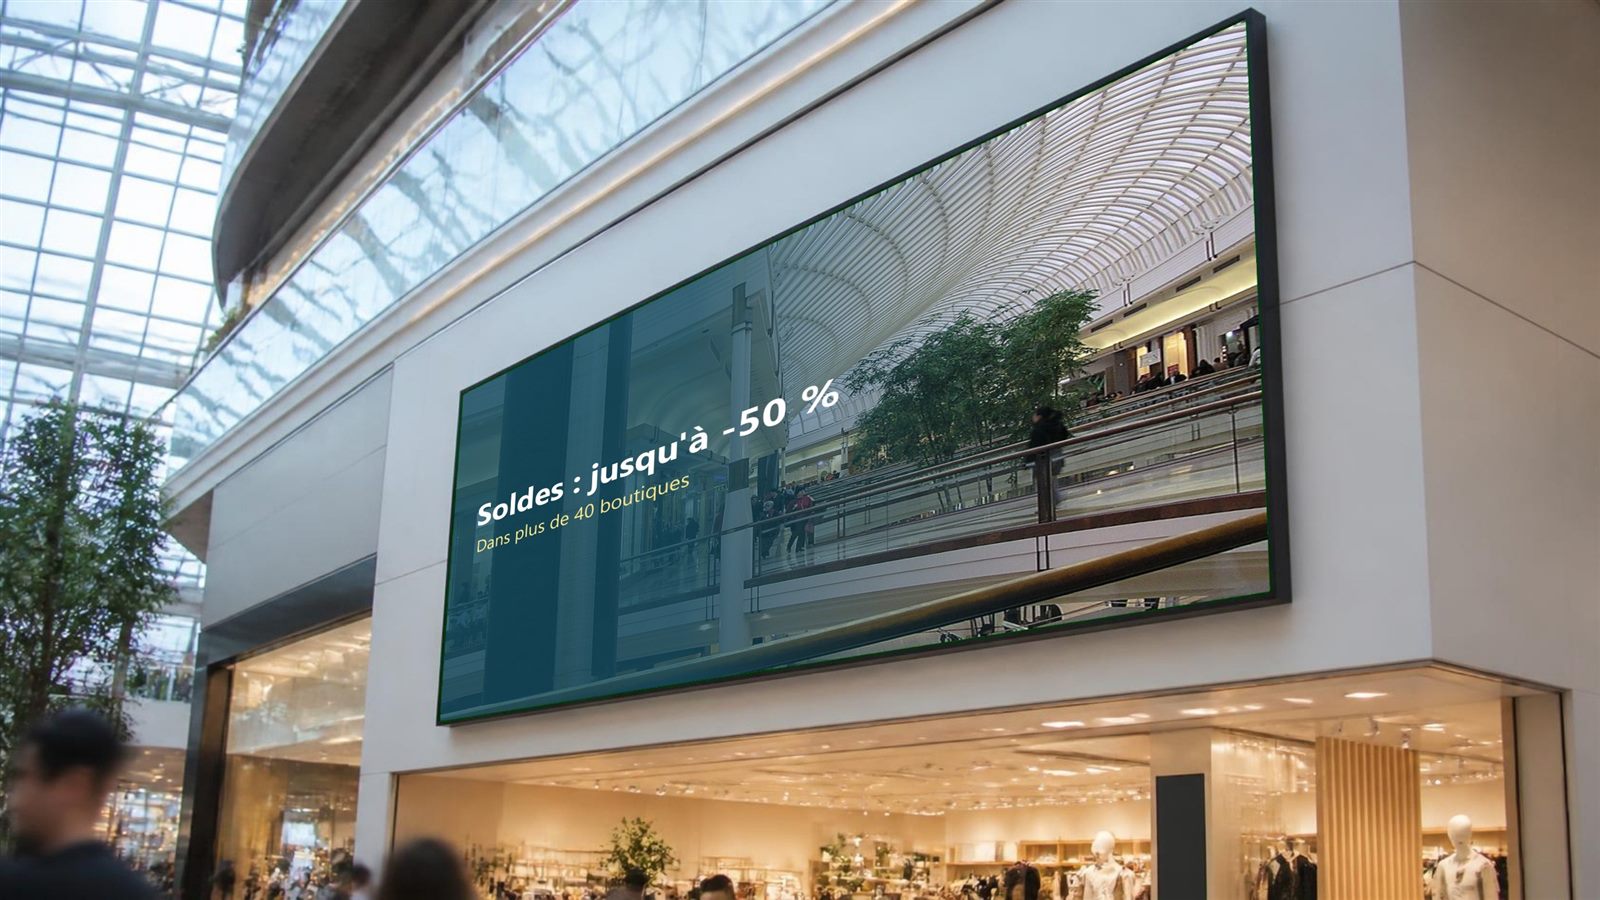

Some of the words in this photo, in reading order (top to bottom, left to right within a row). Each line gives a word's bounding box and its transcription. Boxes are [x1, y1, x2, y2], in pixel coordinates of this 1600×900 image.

[477, 482, 564, 526] Soldes
[573, 476, 581, 494] :
[586, 426, 708, 496] jusqu'à
[722, 397, 786, 436] -50
[802, 378, 840, 414] %
[477, 533, 510, 553] Dans
[515, 522, 545, 544] plus
[550, 513, 569, 530] de
[574, 503, 595, 520] 40
[600, 475, 690, 514] boutiques
